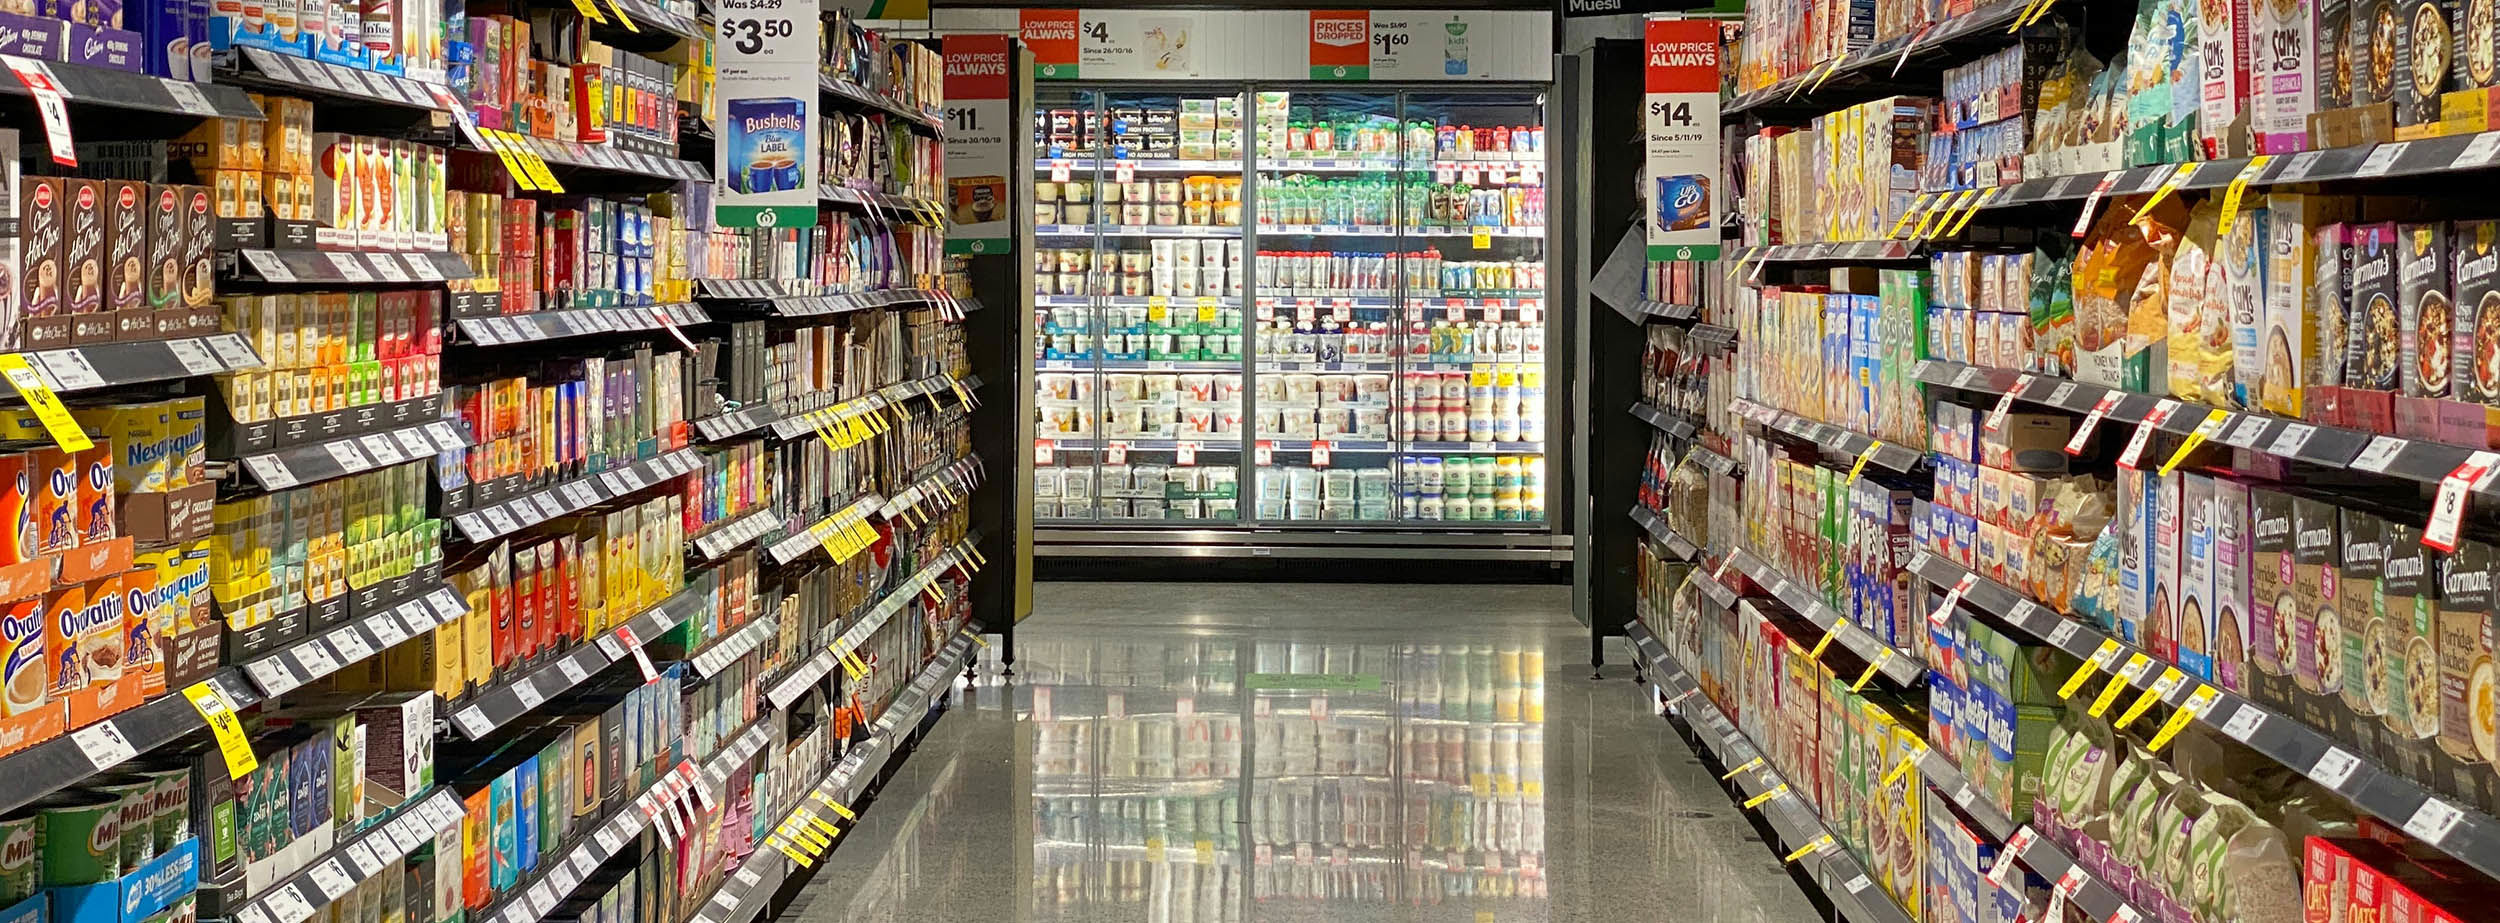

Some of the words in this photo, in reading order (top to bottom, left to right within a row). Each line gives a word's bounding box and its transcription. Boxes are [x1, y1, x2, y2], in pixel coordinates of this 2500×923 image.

[723, 0, 748, 9] Was
[1024, 20, 1046, 29] LOW
[1047, 20, 1076, 29] PRICE
[1083, 21, 1109, 44] $4
[1316, 22, 1363, 32] PRICES
[1024, 29, 1076, 39] ALWAYS
[1316, 32, 1363, 40] DROPPED
[1650, 43, 1678, 53] LOW
[1681, 42, 1715, 53] PRICE
[946, 53, 972, 63] LOW
[973, 53, 1006, 63] PRICE
[1650, 53, 1716, 67] ALWAYS
[946, 63, 1006, 76] ALWAYS
[746, 112, 801, 134] Bushells
[947, 107, 976, 131] $11
[1651, 101, 1693, 127] $14
[1651, 134, 1673, 142] Since
[1674, 134, 1703, 142] 5/11/19
[761, 143, 787, 153] LABEL
[1674, 193, 1700, 209] GO
[2457, 245, 2498, 284] Carman's
[2255, 507, 2289, 539] Carman's
[2296, 517, 2331, 549] Carman's
[2383, 543, 2424, 580] Carman's
[2440, 620, 2474, 653] Porridge
[2311, 846, 2327, 864] UNCLE
[2356, 867, 2375, 890] UNCLE
[2306, 879, 2329, 911] OATS
[2392, 890, 2409, 914] UNCLE
